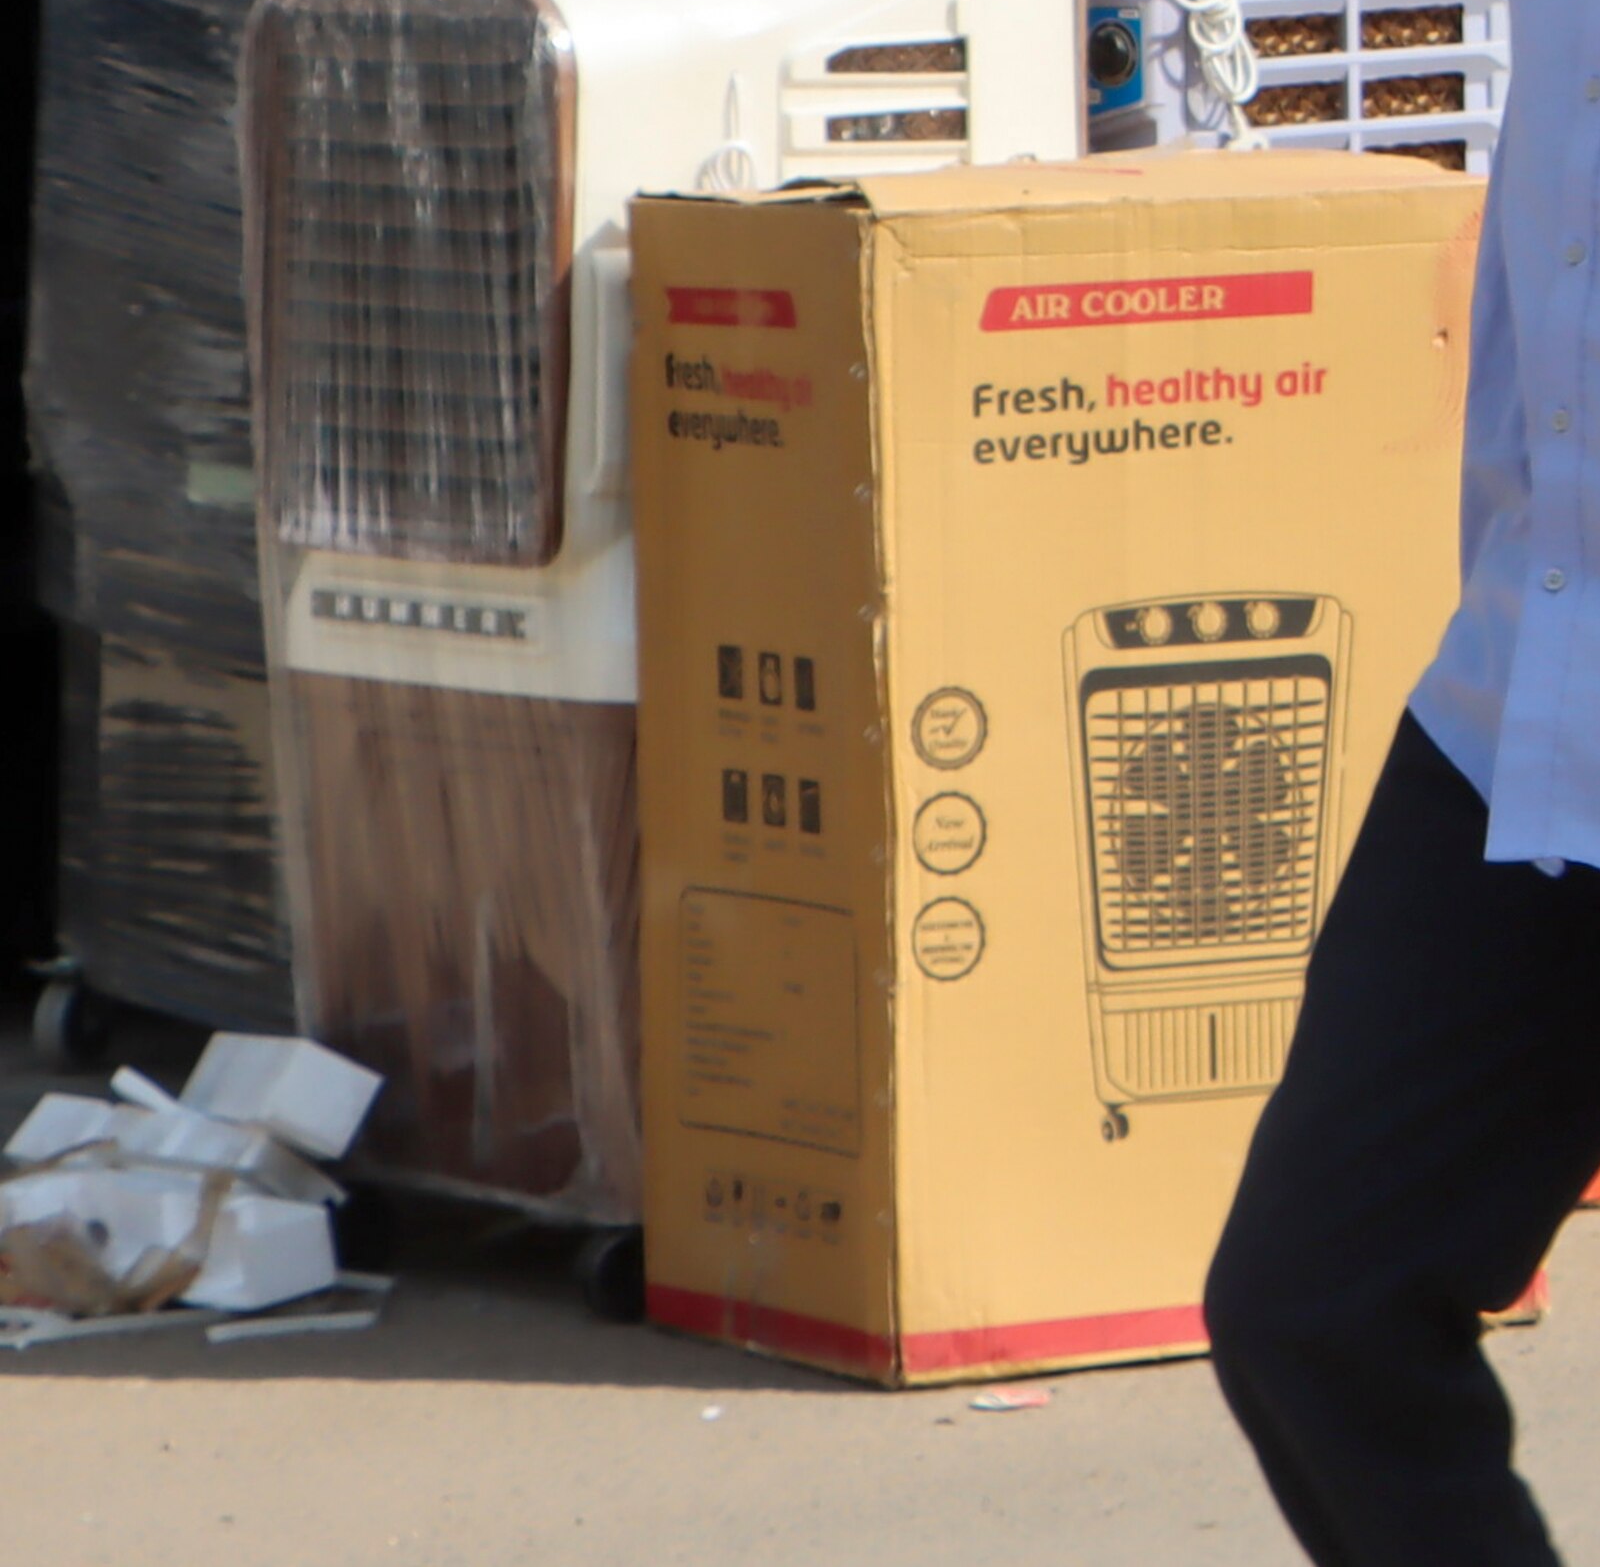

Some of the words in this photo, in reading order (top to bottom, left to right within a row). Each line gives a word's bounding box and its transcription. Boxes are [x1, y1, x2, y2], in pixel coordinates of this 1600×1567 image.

[1008, 295, 1072, 323] AIR
[1080, 284, 1226, 318] COOLER
[972, 378, 1096, 419] Fresh,
[1104, 367, 1264, 408] healthy
[1273, 362, 1328, 398] air
[972, 419, 1235, 466] everywhere.
